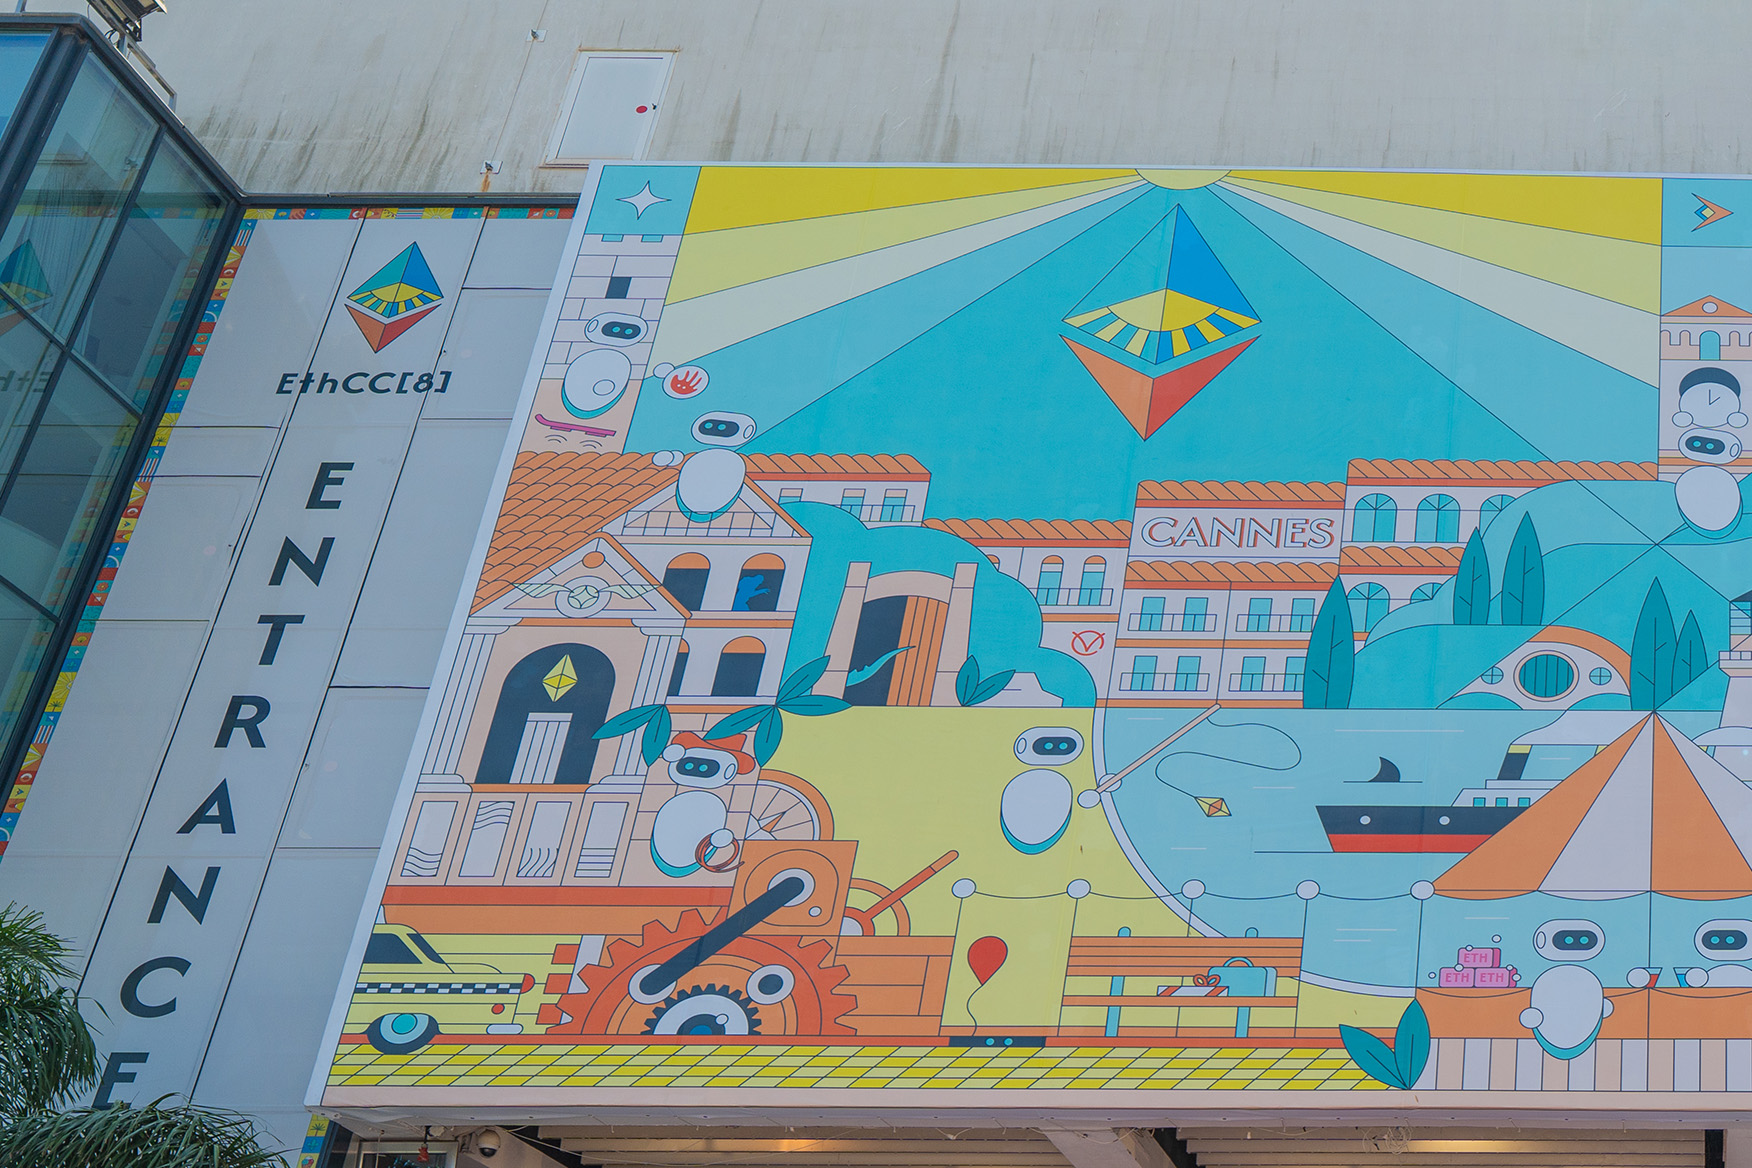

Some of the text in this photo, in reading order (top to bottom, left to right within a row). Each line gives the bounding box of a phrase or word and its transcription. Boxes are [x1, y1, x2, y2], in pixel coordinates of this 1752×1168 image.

[276, 370, 452, 395] EthCC[8]
[1141, 516, 1335, 548] CANNES
[92, 462, 355, 1110] ENTRANCE
[1463, 952, 1489, 963] ETH
[1445, 972, 1470, 983] ETH
[1480, 972, 1505, 983] ETH
